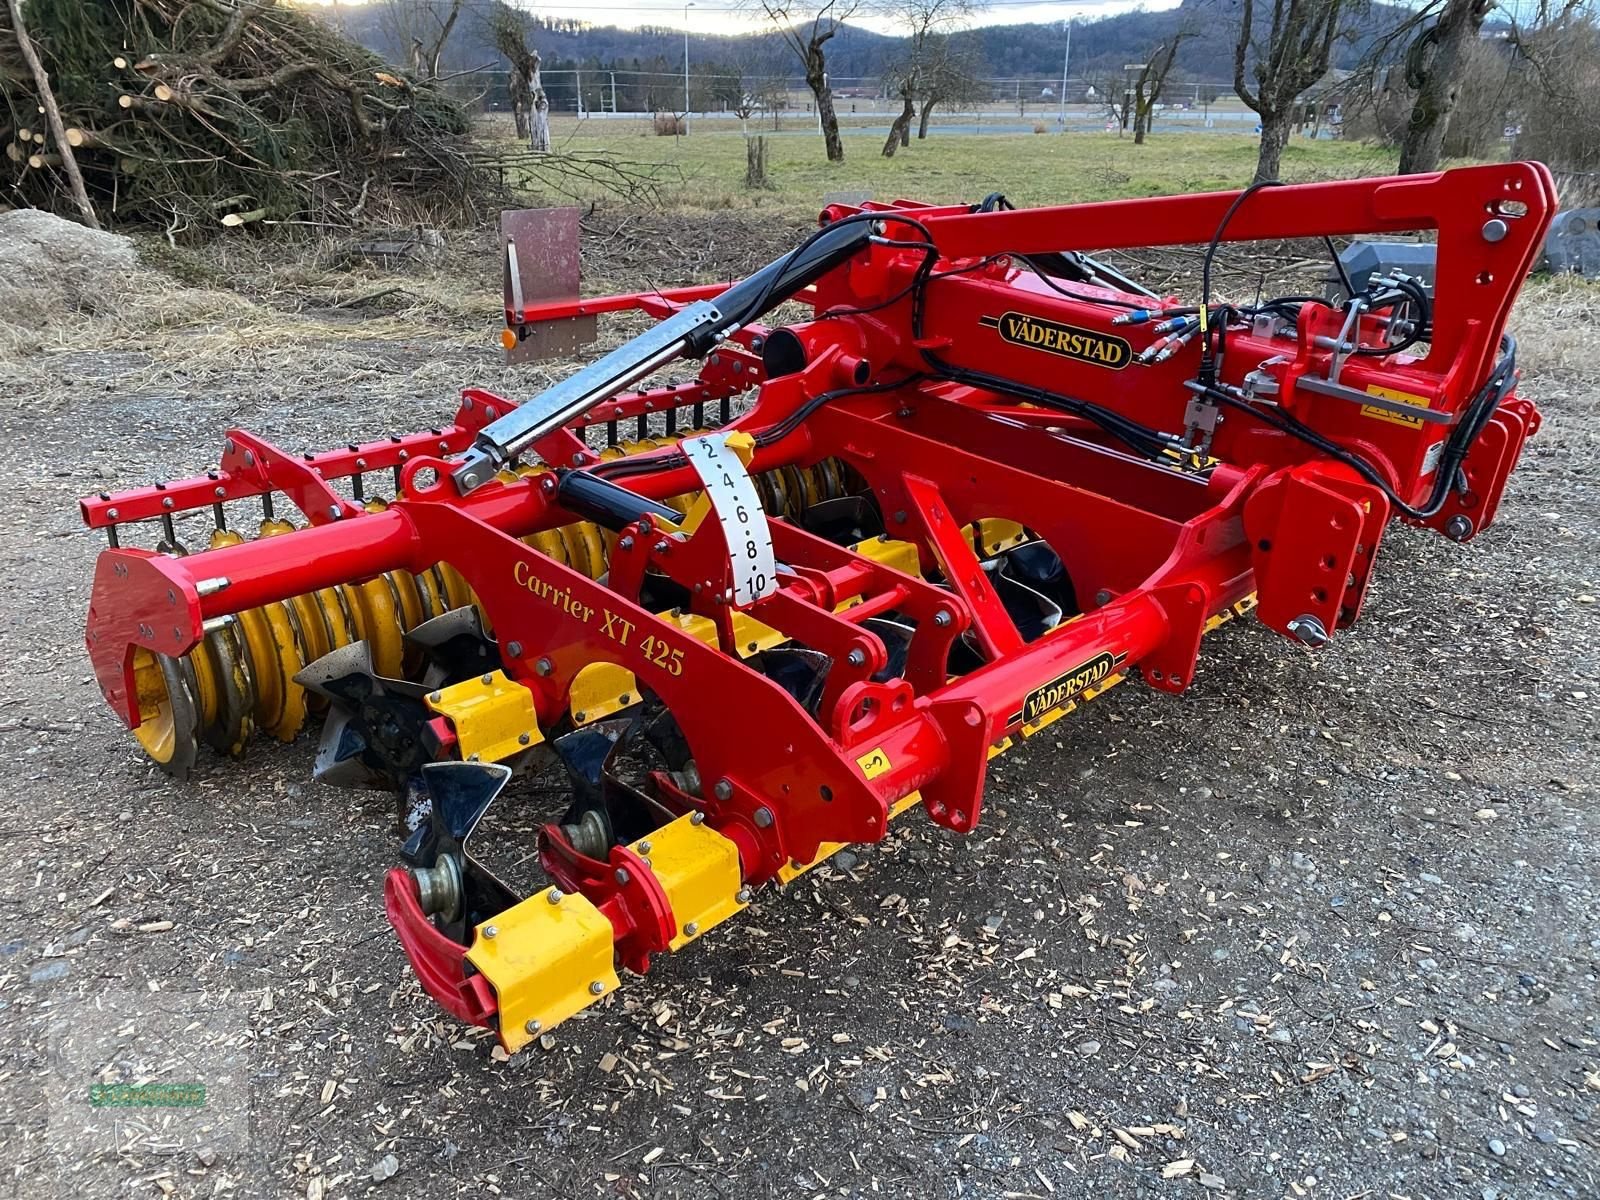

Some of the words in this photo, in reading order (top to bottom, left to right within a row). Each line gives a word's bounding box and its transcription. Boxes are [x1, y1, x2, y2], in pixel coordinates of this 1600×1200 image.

[1008, 316, 1122, 363] VÄDERSTAD
[702, 443, 718, 459] 2
[723, 473, 735, 488] 4
[736, 505, 749, 523] 6
[746, 540, 757, 559] 8
[746, 574, 766, 594] 10
[513, 560, 595, 623] Carrier
[599, 608, 636, 646] XT
[639, 635, 685, 676] 425
[1029, 660, 1109, 718] VÄDERSTAD
